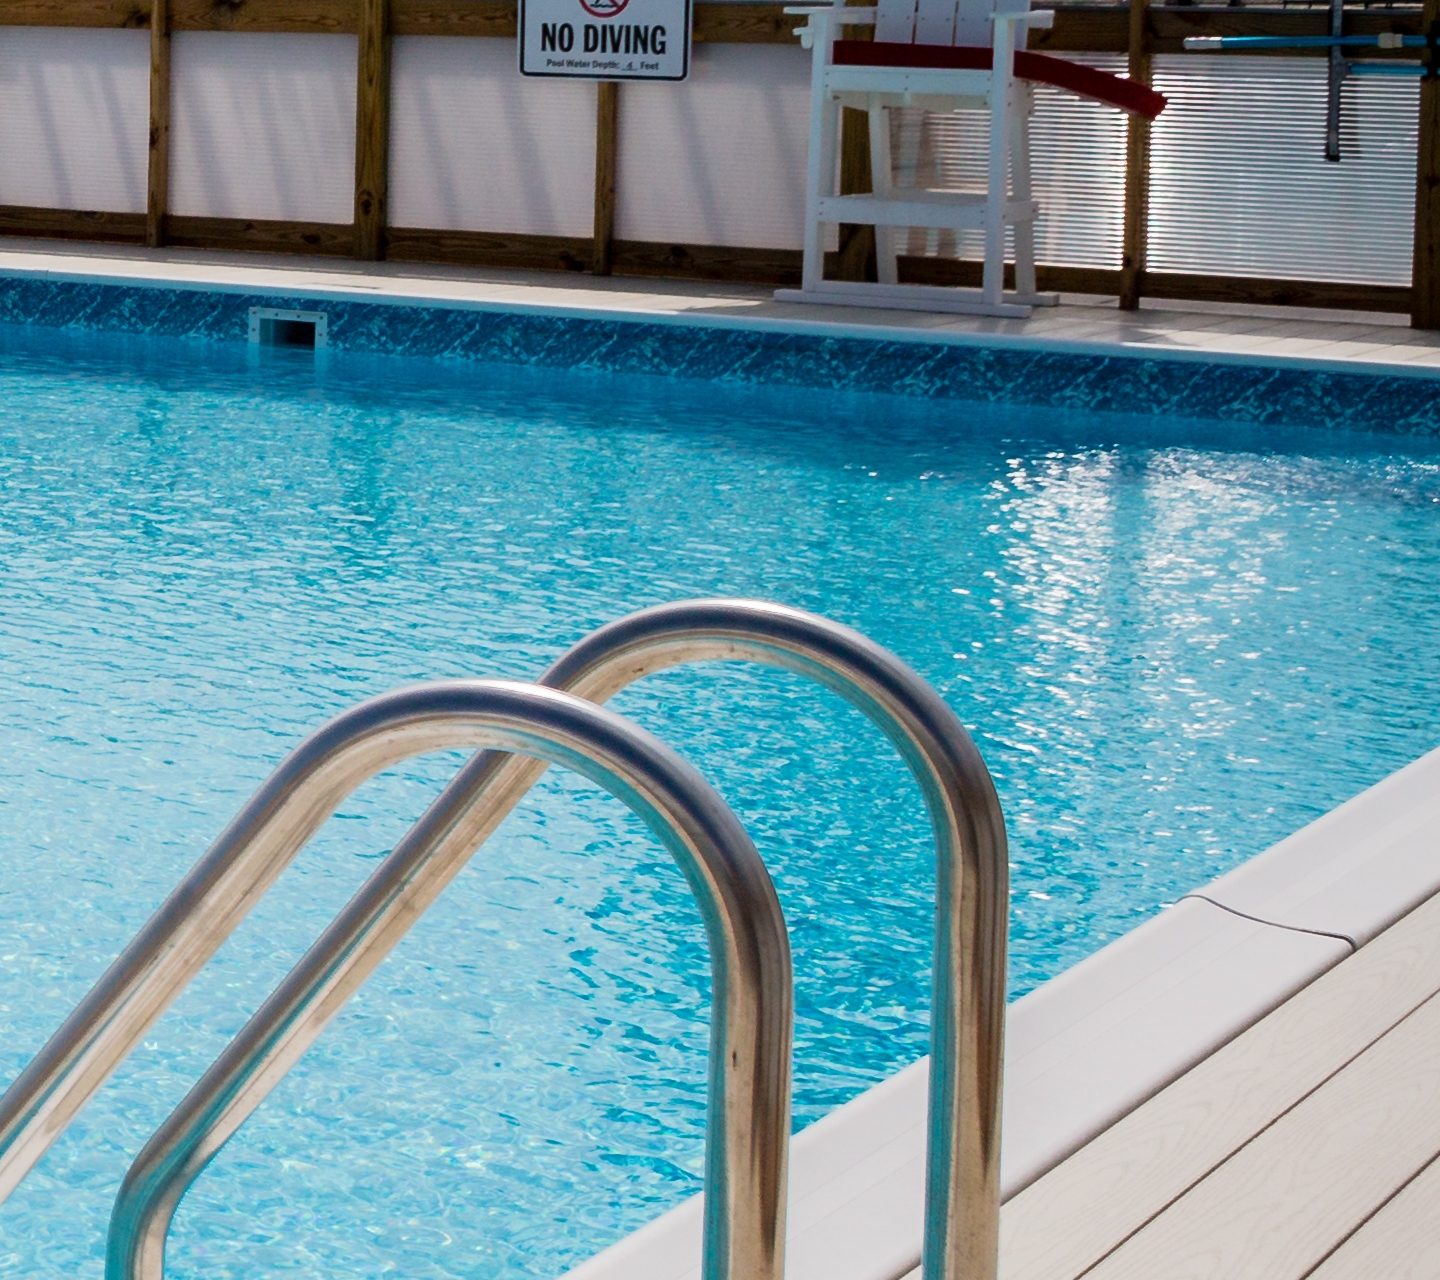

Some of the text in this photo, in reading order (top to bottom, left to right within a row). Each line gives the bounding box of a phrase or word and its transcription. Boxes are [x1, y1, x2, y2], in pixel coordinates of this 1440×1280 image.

[541, 22, 667, 55] NO DIVING
[546, 58, 565, 67] Pool
[566, 59, 591, 68] Water
[640, 61, 660, 70] Feet
